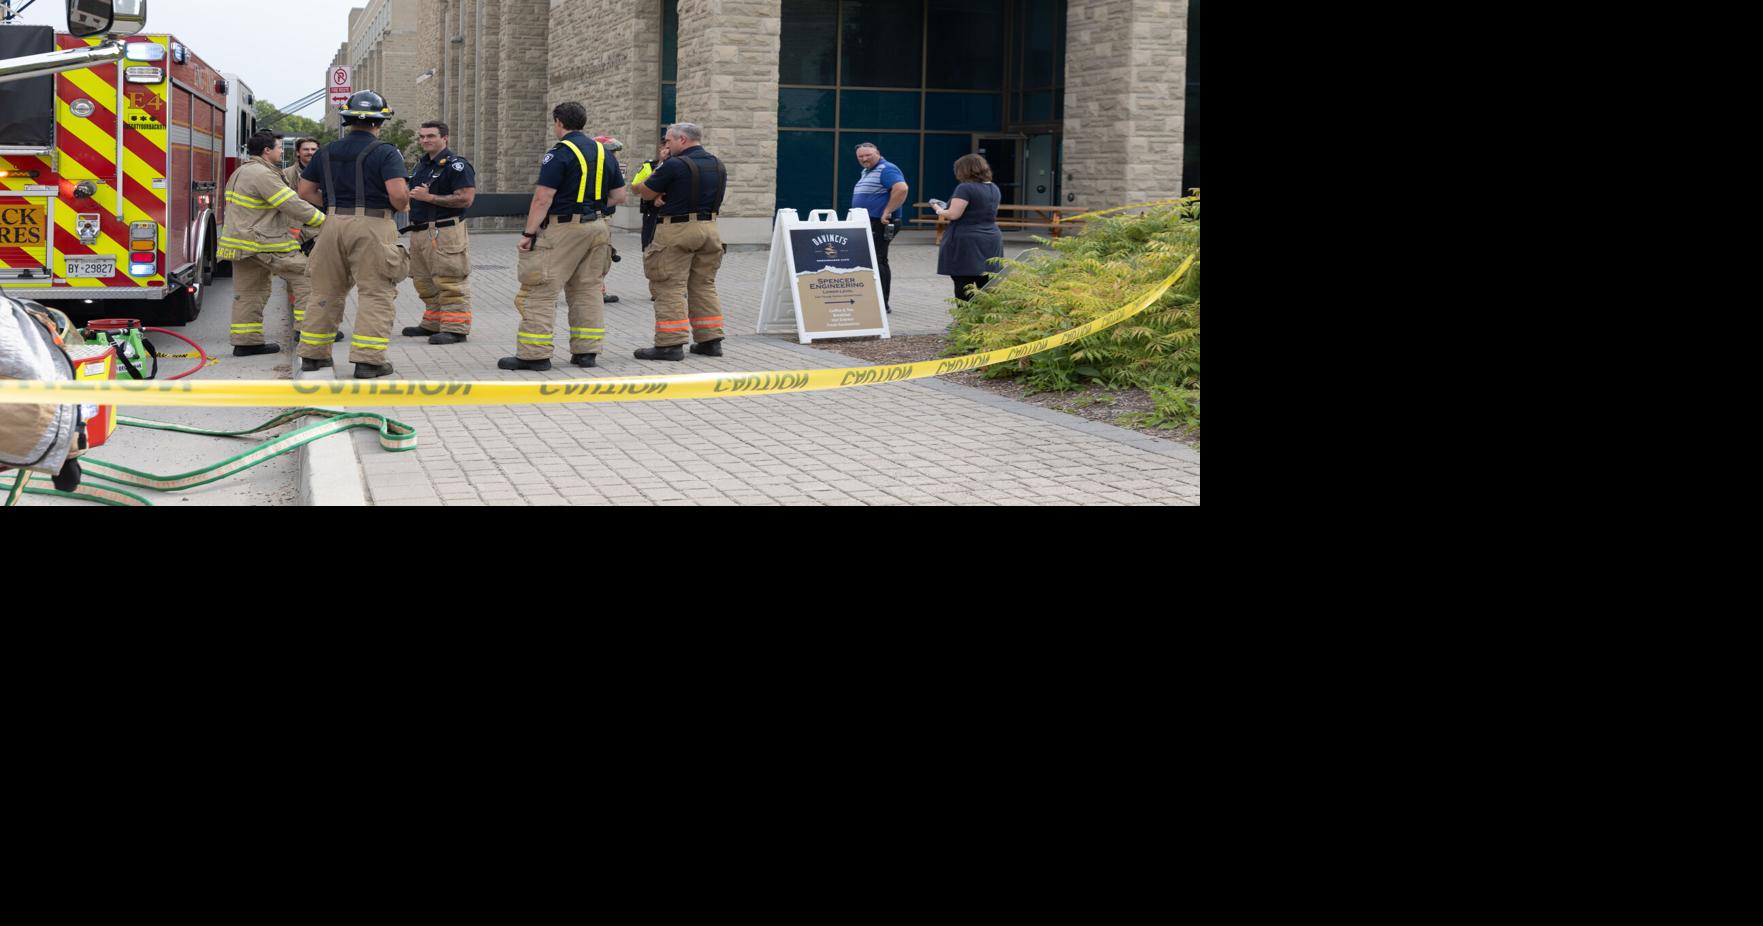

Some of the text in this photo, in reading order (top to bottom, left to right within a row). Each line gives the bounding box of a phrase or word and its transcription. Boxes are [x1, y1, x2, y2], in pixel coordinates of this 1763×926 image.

[128, 91, 163, 111] E4
[0, 207, 37, 225] CK
[812, 233, 848, 246] DAVINCI'S
[85, 263, 113, 273] 29827
[809, 282, 864, 290] ENGINEERING
